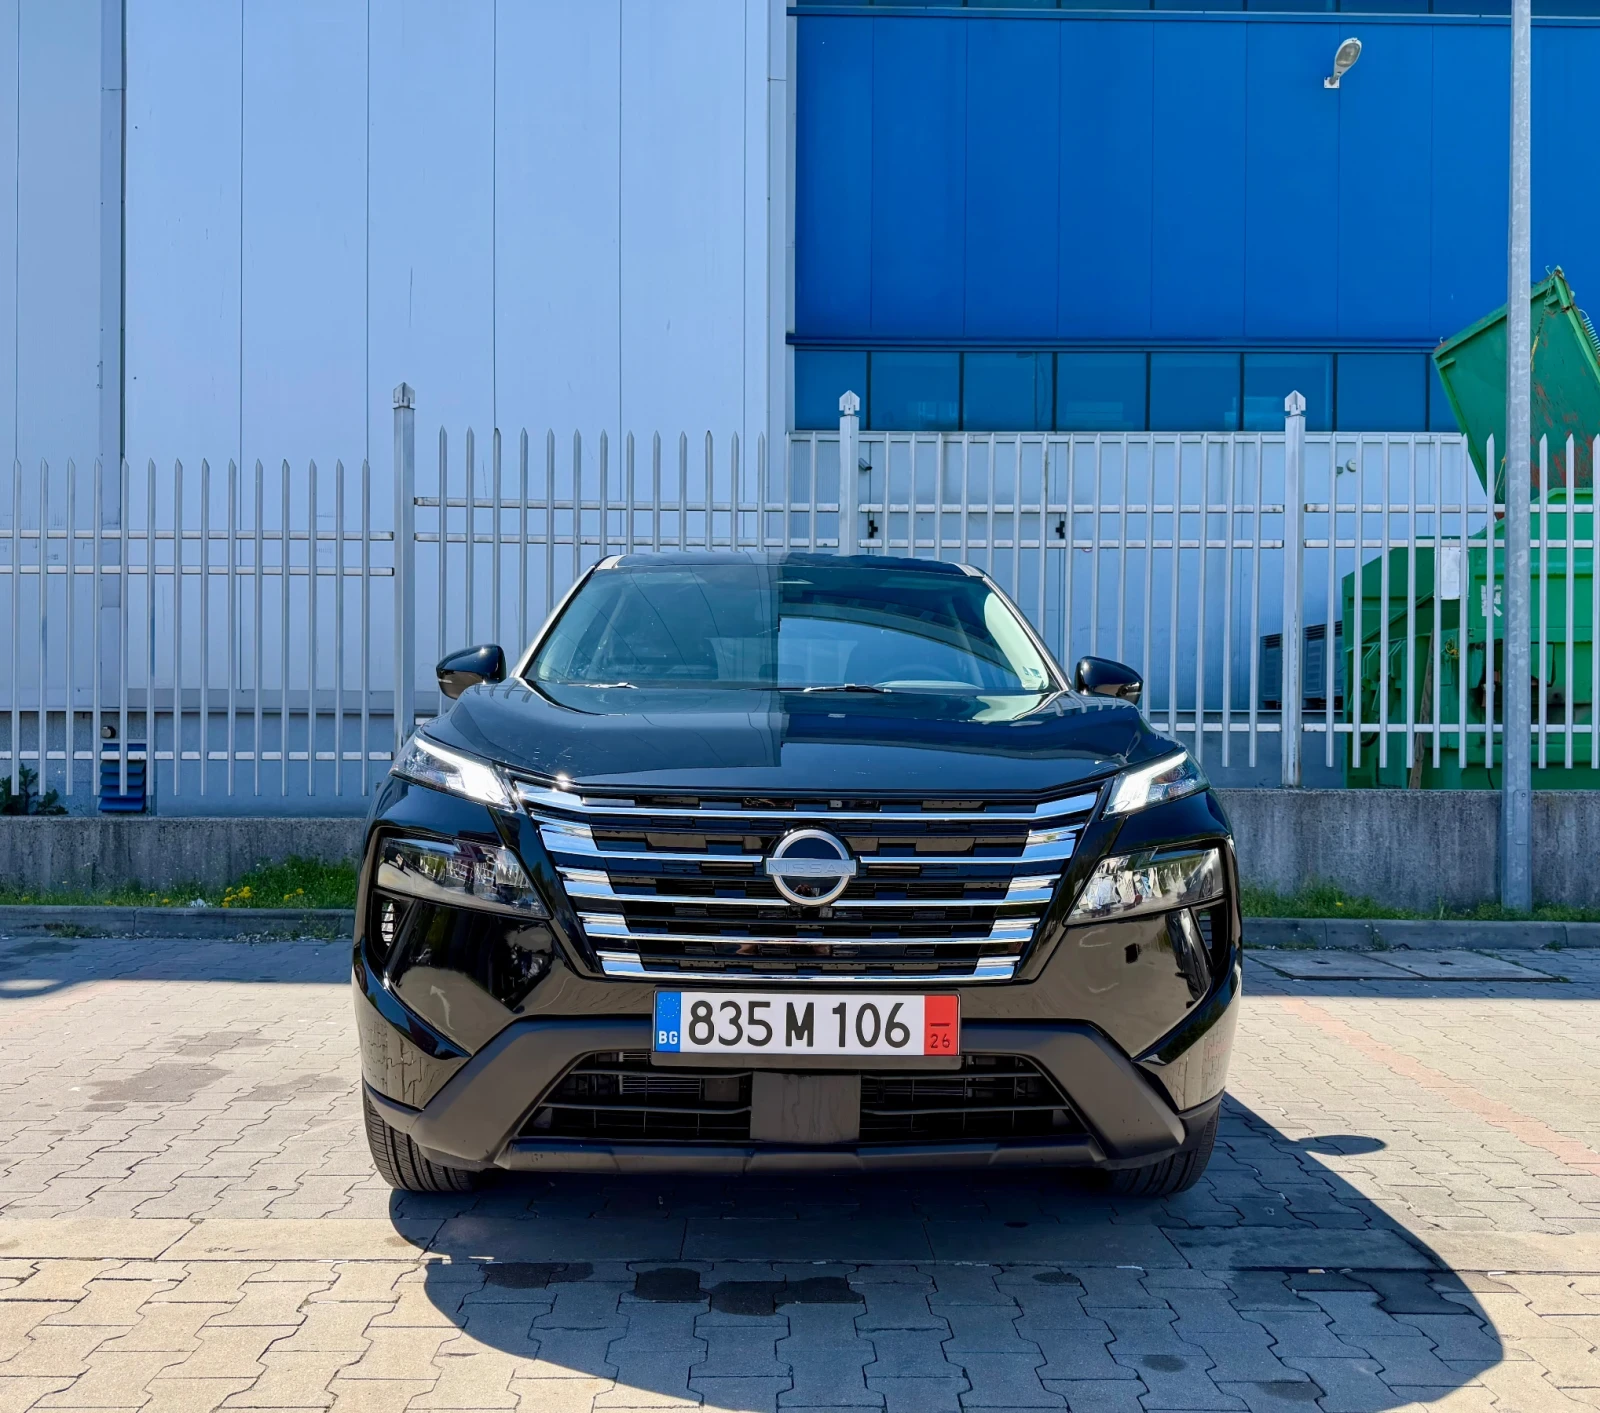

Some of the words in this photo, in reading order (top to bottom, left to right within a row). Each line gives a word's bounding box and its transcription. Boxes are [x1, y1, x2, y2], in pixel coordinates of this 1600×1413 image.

[768, 861, 855, 874] NISSAN
[688, 1000, 773, 1047] 835
[785, 1002, 814, 1047] M
[832, 1002, 910, 1048] 106
[658, 1030, 678, 1045] BG
[930, 1032, 950, 1049] 26
